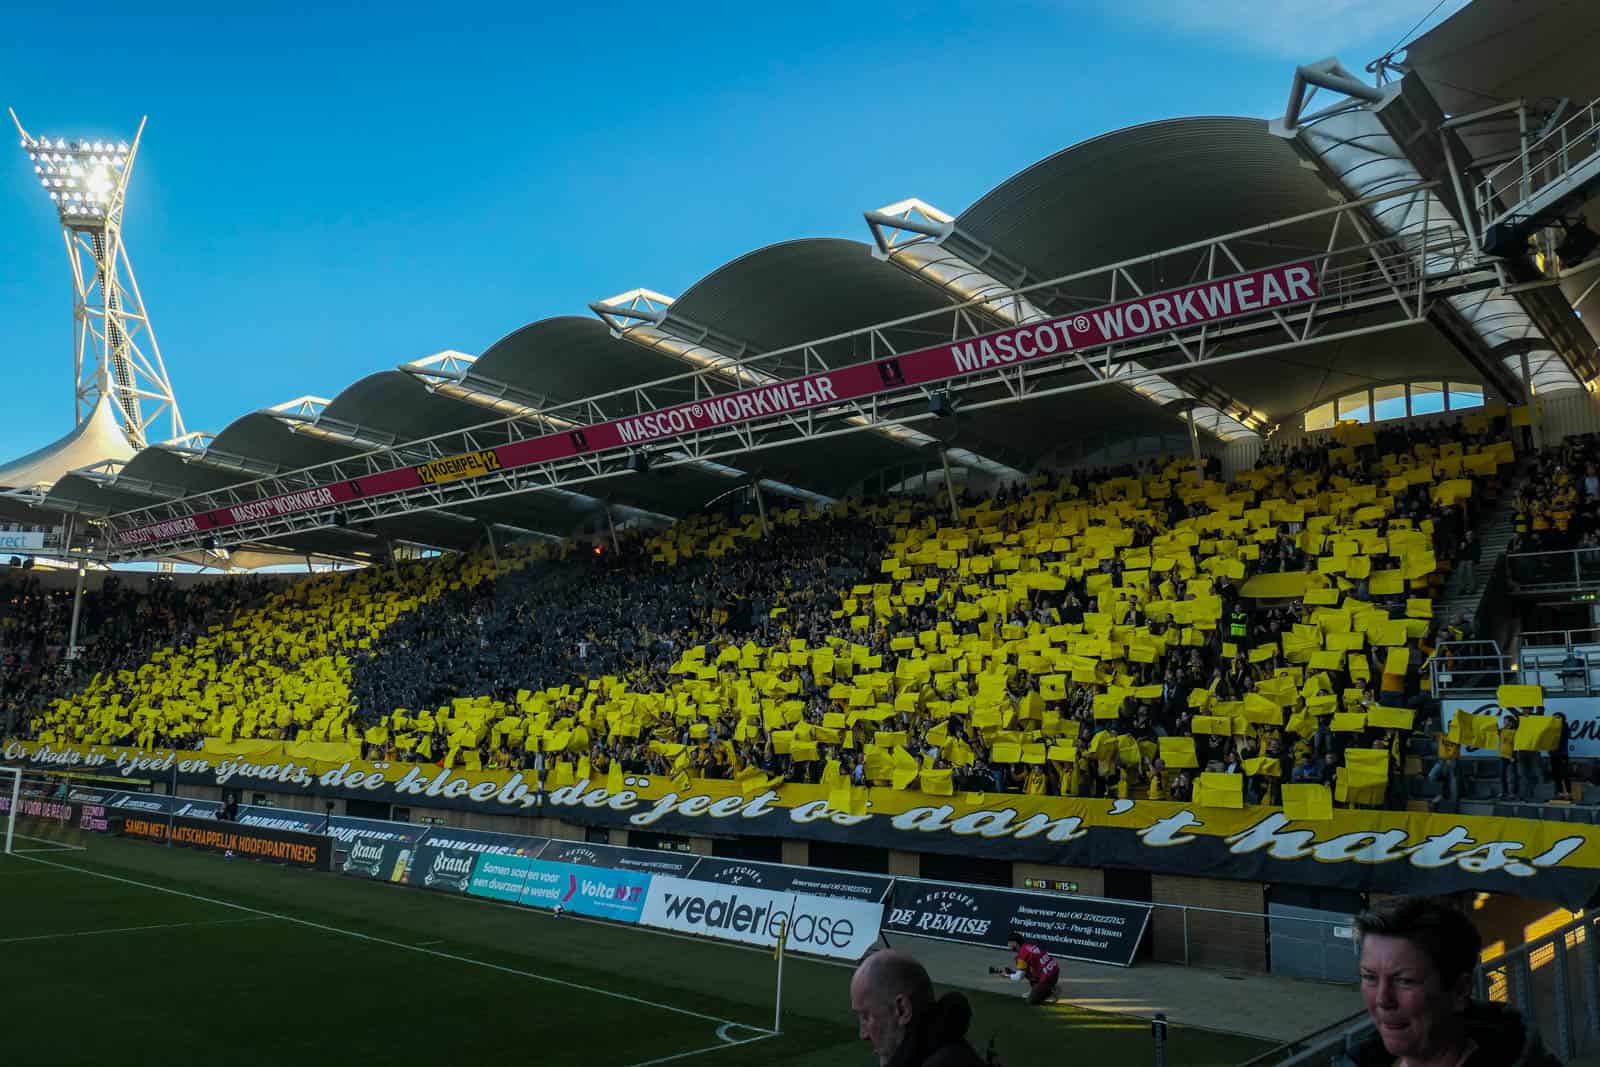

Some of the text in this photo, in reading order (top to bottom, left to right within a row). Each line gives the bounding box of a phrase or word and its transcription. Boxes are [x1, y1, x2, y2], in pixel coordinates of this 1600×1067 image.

[1093, 265, 1315, 341] WORKWEAR
[705, 376, 837, 423] WORKWEAR
[432, 455, 482, 475] KOEMPEL
[272, 487, 335, 513] WORKWEAR
[153, 516, 198, 539] WORKWEAR
[4, 742, 26, 761] Os
[30, 745, 81, 765] Roda
[85, 747, 106, 766] in
[178, 758, 208, 775] en
[319, 762, 390, 790] deë
[547, 776, 649, 811] deë
[629, 790, 781, 825] jeet
[891, 804, 1088, 842] aan
[1226, 811, 1587, 877] hats!
[123, 817, 150, 835] SAMEN
[151, 821, 165, 837] MET
[239, 835, 318, 864] HOOFDPARTNERS
[352, 839, 385, 860] Brand
[433, 850, 473, 874] Brand
[482, 862, 510, 875] Samen
[540, 872, 560, 883] voor
[473, 877, 488, 887] een
[530, 887, 560, 899] wereld
[887, 908, 992, 936] DE REMISE
